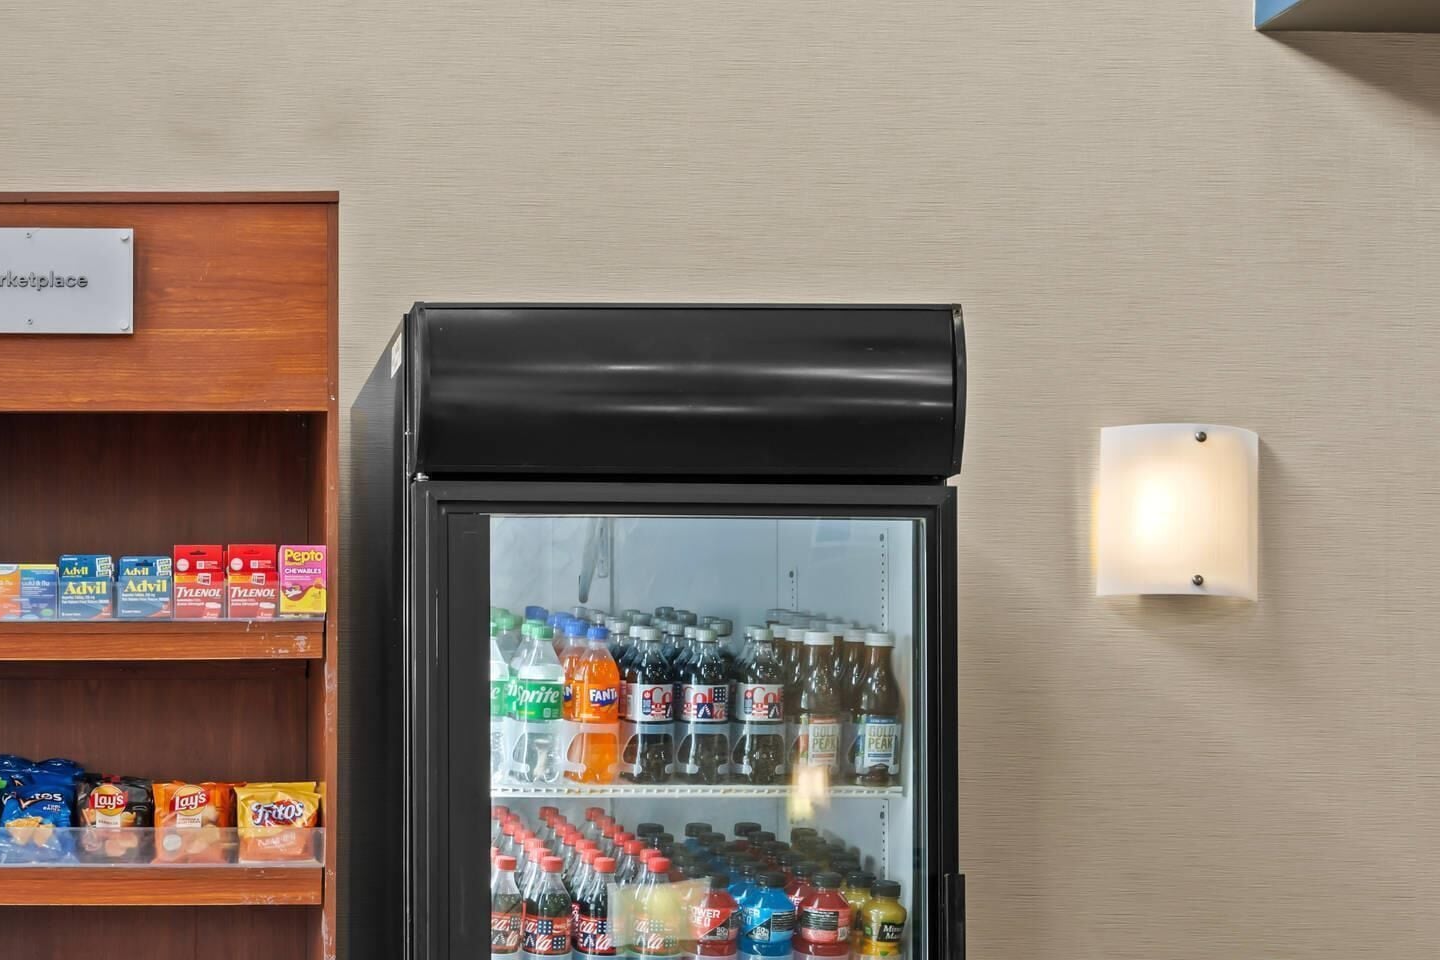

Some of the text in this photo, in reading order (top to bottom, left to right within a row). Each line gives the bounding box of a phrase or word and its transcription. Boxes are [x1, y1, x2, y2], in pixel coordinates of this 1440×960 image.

[285, 548, 324, 562] Pepto
[63, 567, 89, 576] Advil
[124, 568, 149, 576] Advil
[64, 581, 107, 594] Advil
[124, 579, 167, 593] Advil
[177, 587, 222, 598] TYLENOL
[231, 587, 276, 598] TYLENOL
[517, 682, 560, 705] Sprite
[812, 737, 835, 749] PEAK
[868, 737, 893, 749] PEAK
[94, 792, 124, 812] Lay's
[175, 792, 207, 811] Lay's
[251, 800, 304, 825] Fritos
